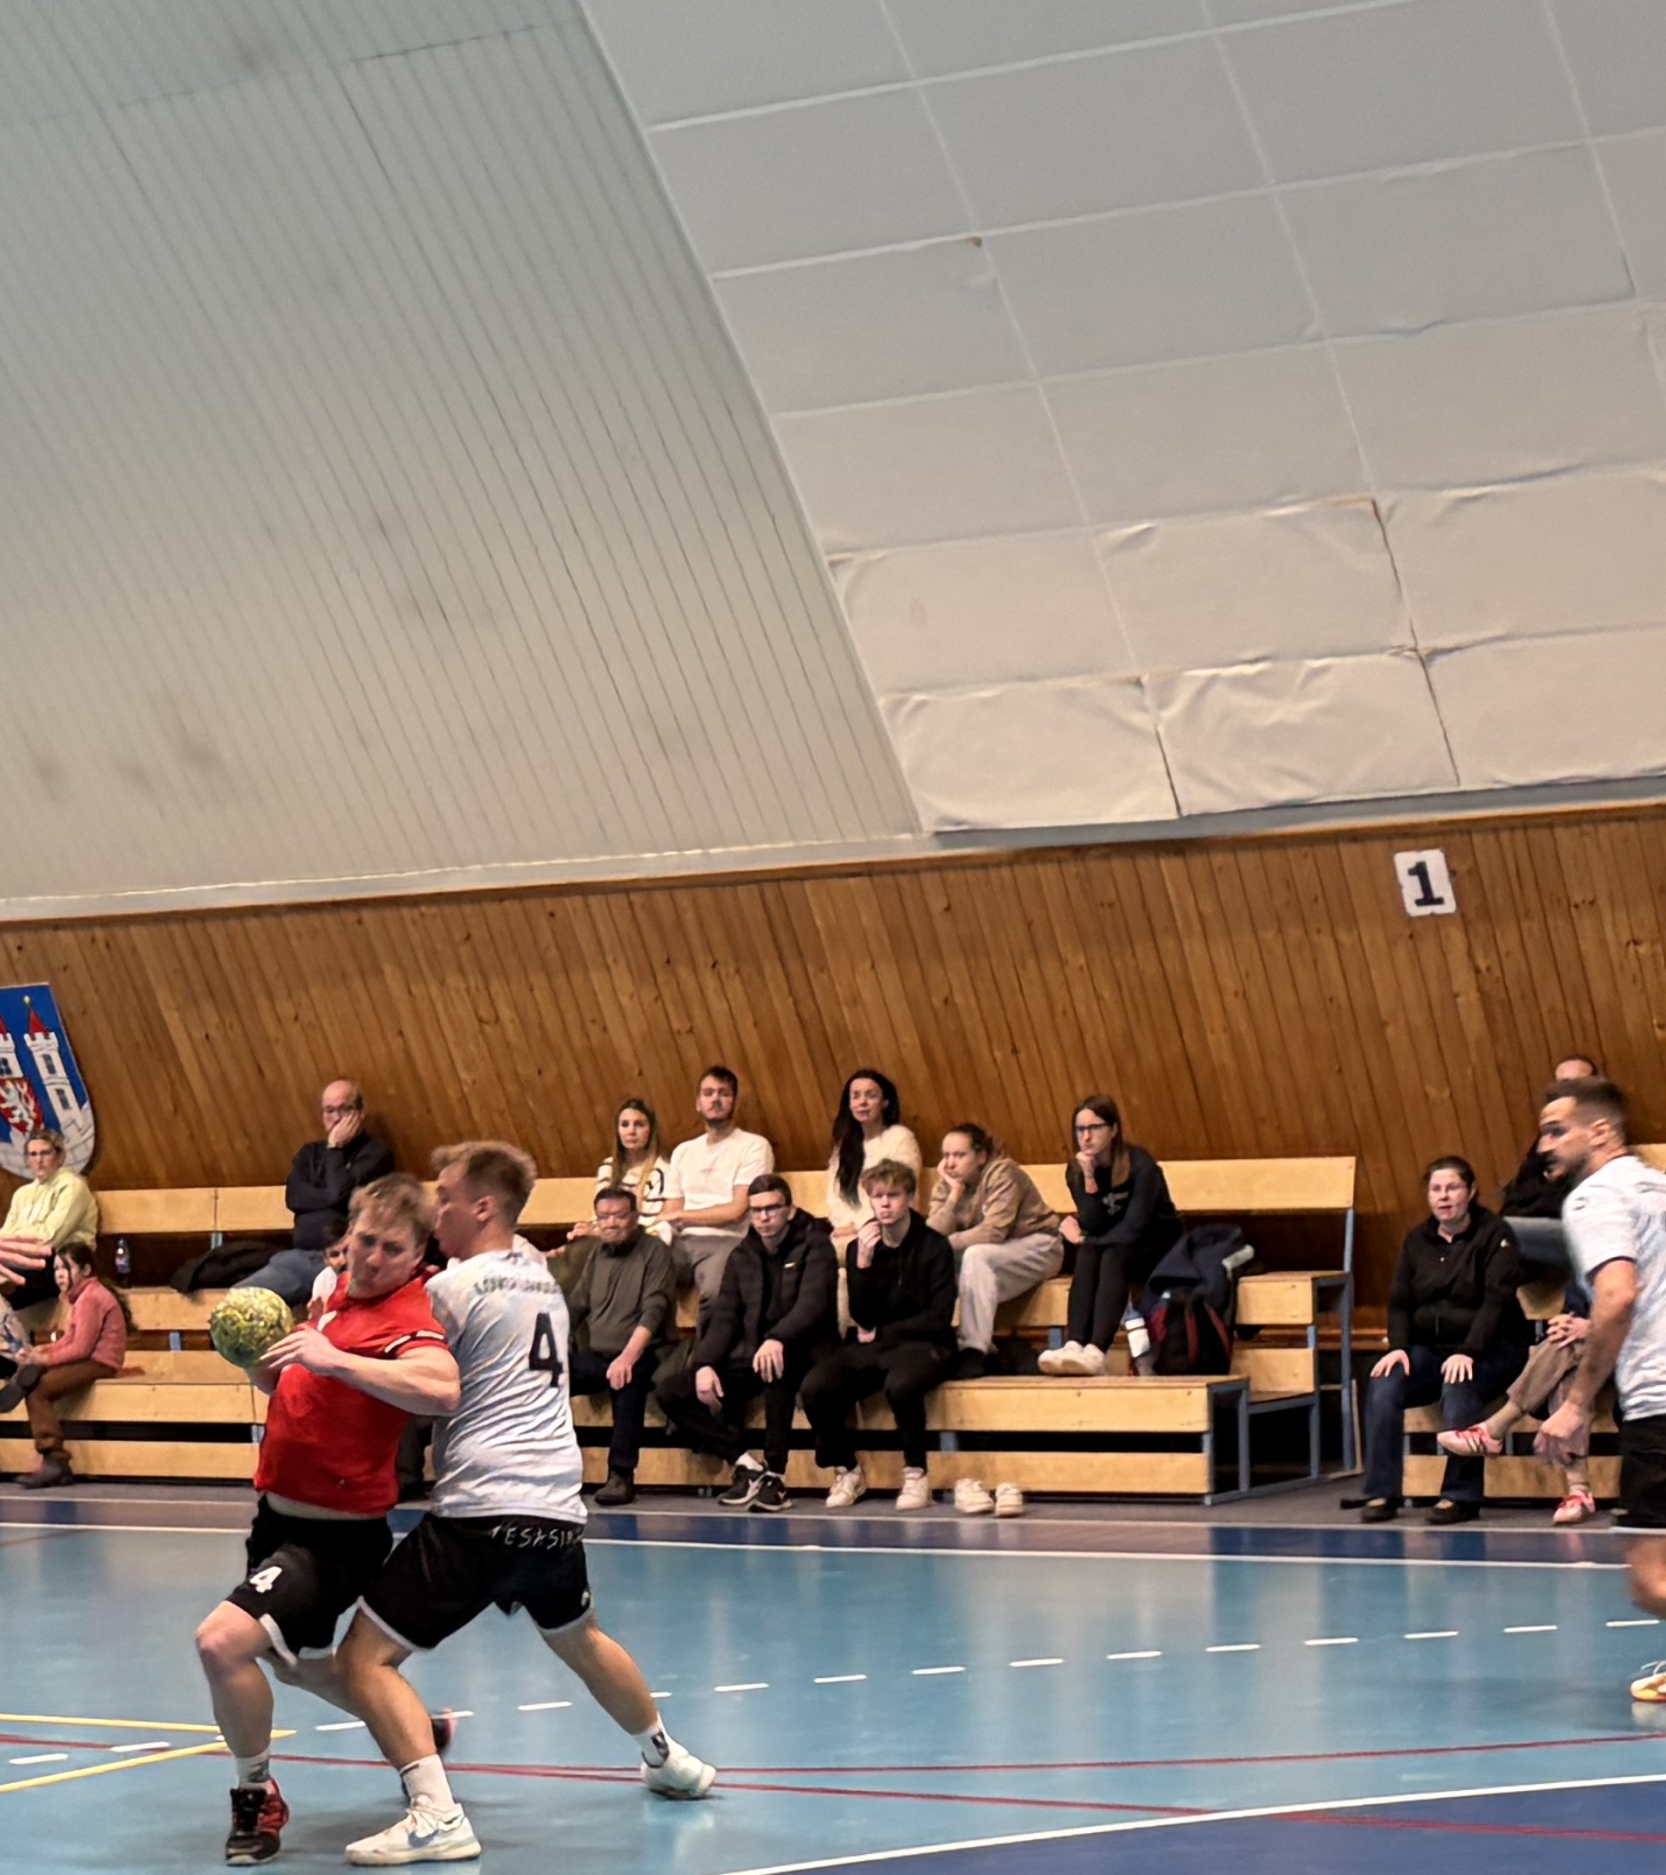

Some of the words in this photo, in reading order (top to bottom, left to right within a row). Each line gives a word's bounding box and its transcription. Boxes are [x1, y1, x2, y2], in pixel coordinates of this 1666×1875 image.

[1407, 861, 1445, 907] 1
[528, 1312, 564, 1388] 4
[249, 1565, 283, 1594] 4
